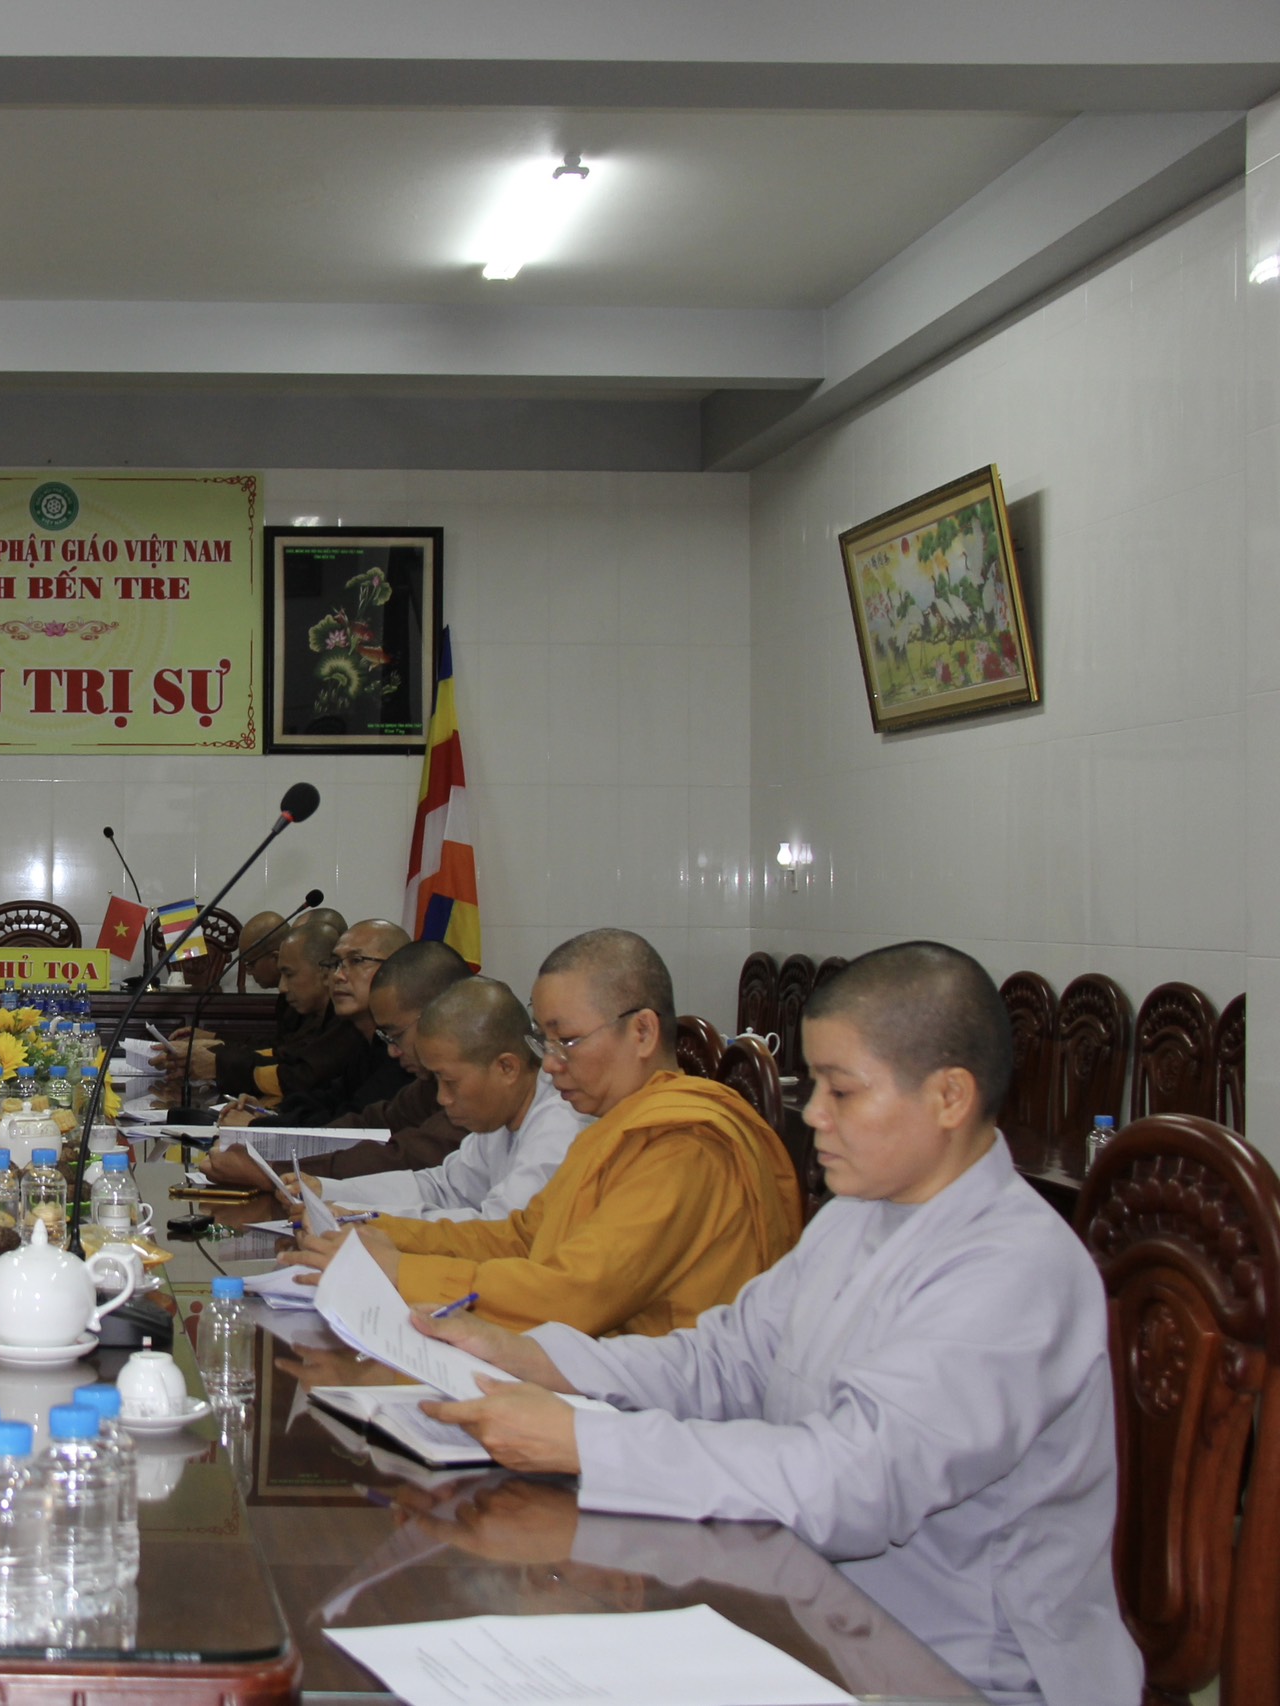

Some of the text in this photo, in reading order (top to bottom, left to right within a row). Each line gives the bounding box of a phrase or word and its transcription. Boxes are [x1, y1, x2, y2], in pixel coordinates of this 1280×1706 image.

[61, 533, 119, 562] GIÁO
[123, 533, 178, 569] VIỆT
[183, 540, 232, 562] NAM
[27, 565, 103, 599] BẾN
[114, 576, 190, 600] TRE
[23, 668, 133, 728] TRỊ
[153, 658, 231, 728] SỰ
[43, 961, 99, 985] TỌA
